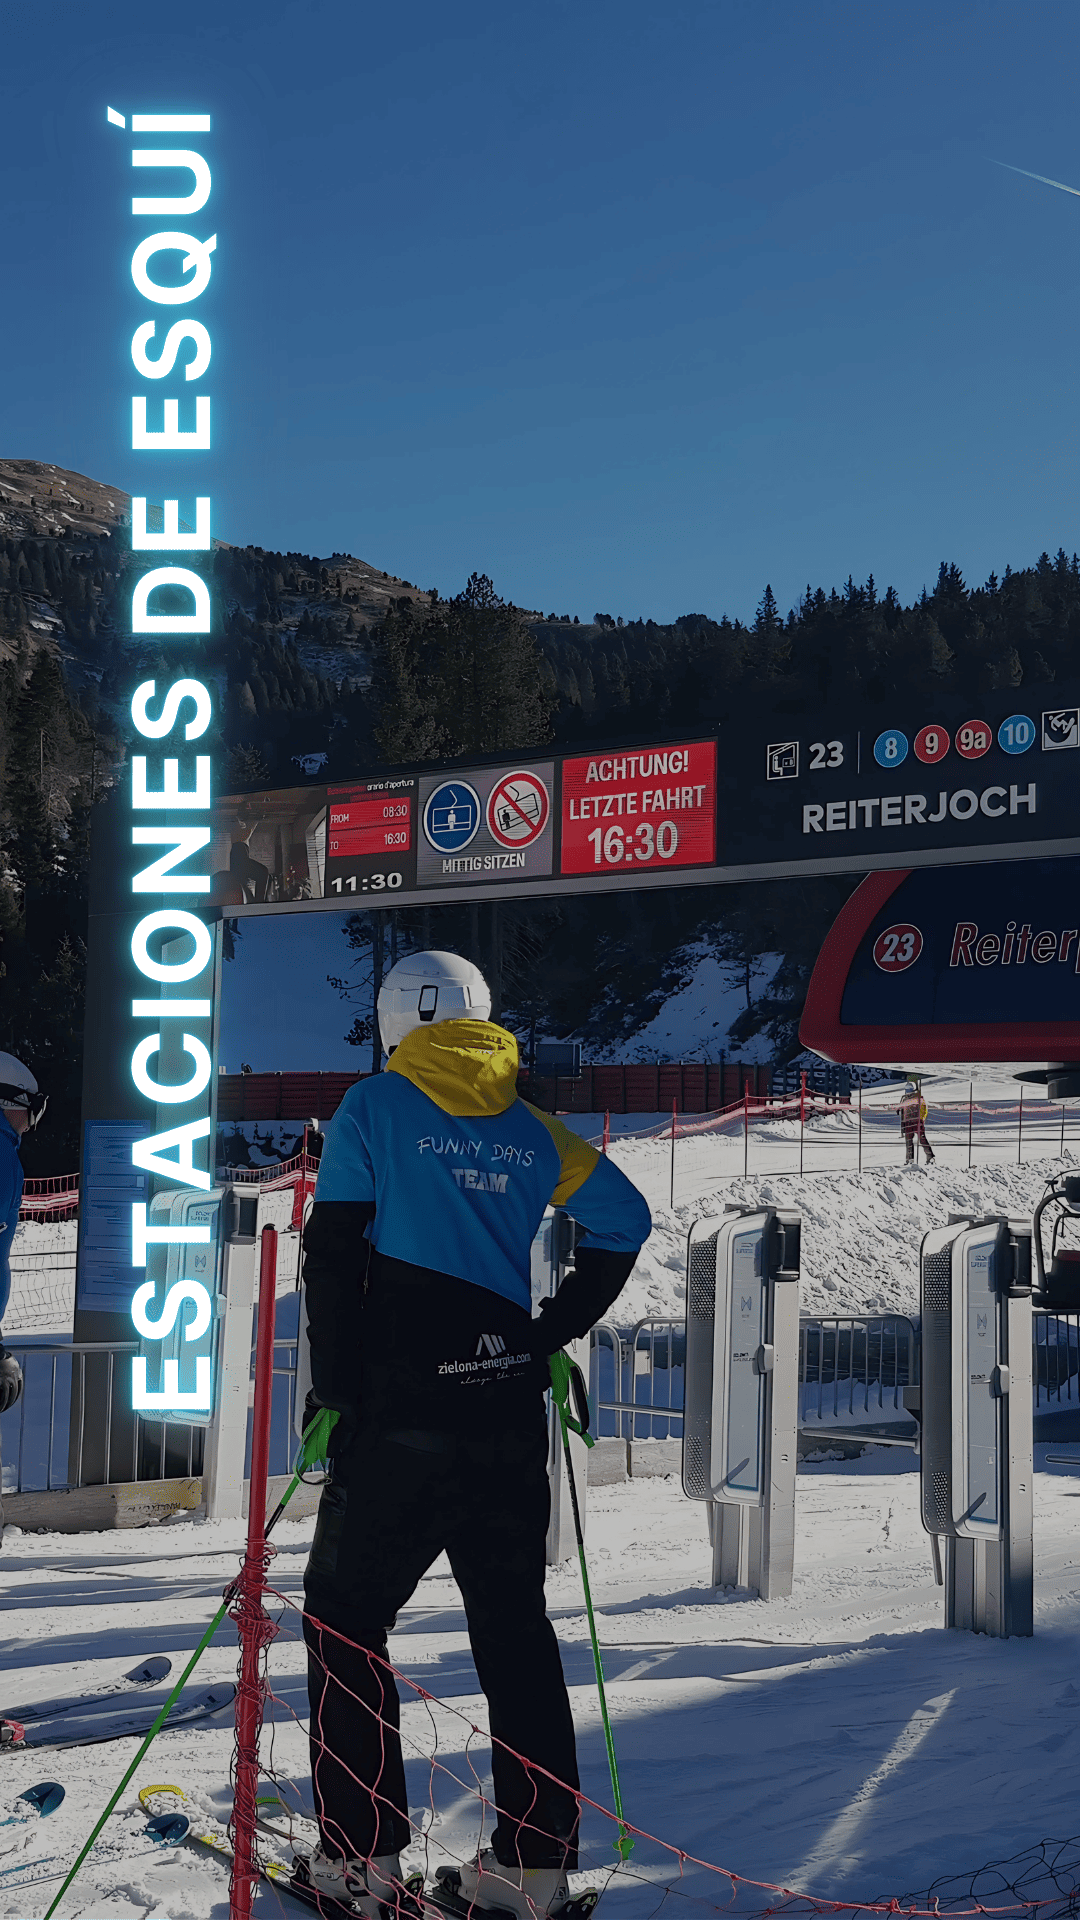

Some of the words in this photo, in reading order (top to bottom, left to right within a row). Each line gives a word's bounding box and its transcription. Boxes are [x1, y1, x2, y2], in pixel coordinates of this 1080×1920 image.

[809, 741, 844, 769] 23
[885, 737, 897, 760] 8
[925, 733, 939, 755] 9
[960, 728, 987, 751] 9a
[1004, 722, 1029, 745] 10
[585, 750, 689, 783] ACHTUNG!
[382, 804, 408, 818] 08:30
[569, 792, 638, 820] LETZTE
[642, 785, 706, 812] FAHRT
[802, 783, 1037, 833] REITERJOCH
[330, 813, 350, 824] FROM
[383, 832, 407, 846] 16:30
[587, 820, 679, 864] 16:30
[483, 852, 526, 870] SITZEN
[331, 872, 403, 893] 11:30
[879, 933, 915, 962] 23
[949, 920, 1080, 974] Reiter
[416, 1136, 482, 1159] FUNNY
[491, 1144, 535, 1168] DAYS
[451, 1168, 509, 1194] TEAM
[437, 1353, 532, 1374] zielona-energia.com
